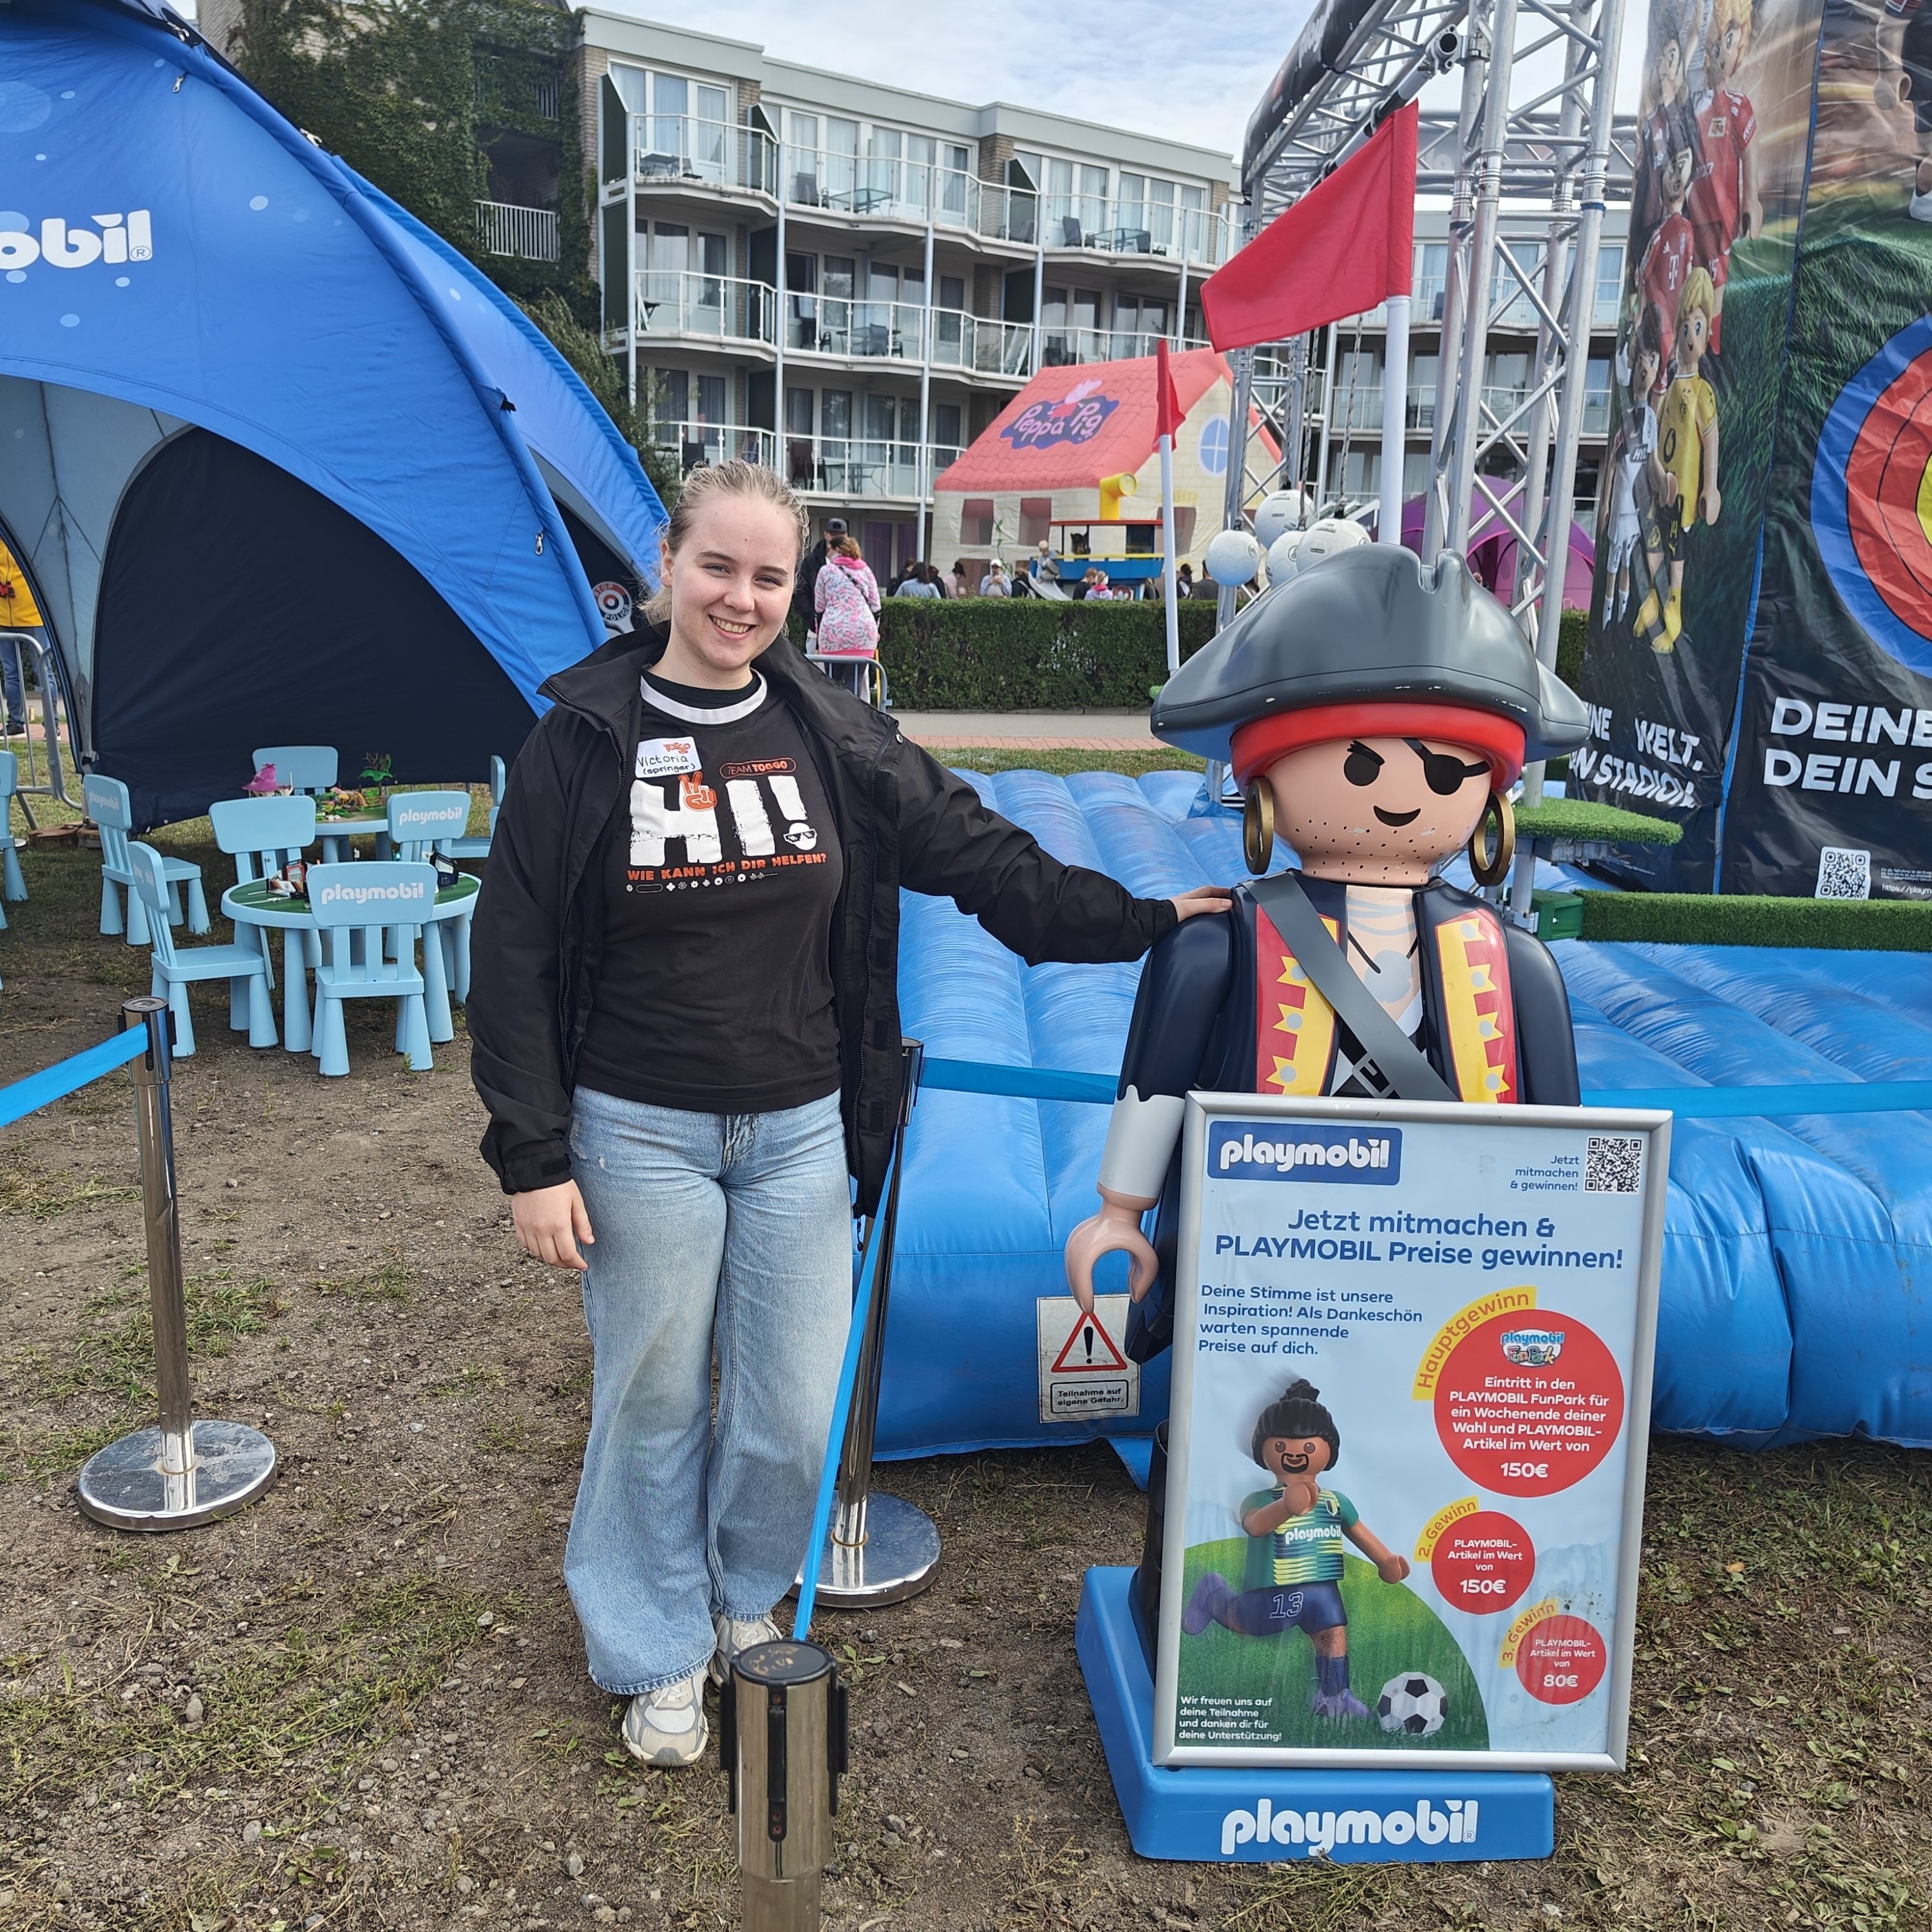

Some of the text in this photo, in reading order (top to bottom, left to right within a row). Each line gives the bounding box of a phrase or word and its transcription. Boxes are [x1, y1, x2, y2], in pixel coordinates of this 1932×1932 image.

[1014, 402, 1103, 443] Peppa Pig
[593, 583, 614, 598] STOP
[1634, 717, 1703, 772] WELT.
[637, 755, 689, 767] Victoria
[1763, 748, 1901, 797] DEIN
[399, 806, 462, 826] playmobil
[630, 775, 817, 866] HI!
[627, 869, 654, 881] WIE
[661, 866, 706, 879] KANN
[741, 858, 766, 869] DIR
[772, 853, 827, 867] HELFEN?
[321, 882, 424, 905] playmobil
[1220, 1134, 1390, 1172] playmobil
[1551, 1155, 1580, 1164] Jetzt
[1515, 1166, 1578, 1178] mitmachen
[1510, 1180, 1578, 1191] & gewinnen!
[1288, 1209, 1555, 1237] Jetzt mitmachen &
[1216, 1235, 1623, 1271] PLAYMOBIL Preise gewinnen!
[1202, 1285, 1394, 1303] Deine Stimme ist unsere
[1204, 1303, 1423, 1322] Inspiration! Als Dankeschön
[1199, 1323, 1349, 1341] warten spannende
[1501, 1331, 1564, 1346] playmobil
[1198, 1340, 1318, 1355] Preise auf dich.
[1417, 1293, 1530, 1388] Hauptgewinn
[1485, 1376, 1575, 1390] Eintritt in den
[1450, 1392, 1609, 1406] PLAYMOBIL FunPark für
[1451, 1406, 1607, 1422] ein Wochenende deiner
[1452, 1422, 1602, 1437] Wahl und PLAYMOBIL-
[1463, 1438, 1590, 1452] Artikel im Wert von
[1501, 1463, 1549, 1477] 150€
[1285, 1525, 1342, 1544] playmobil
[1419, 1502, 1476, 1557] 2. Gewinn
[1454, 1539, 1517, 1548] PLAYMOBIL-
[1448, 1551, 1522, 1560] Artikel im Wert
[1460, 1579, 1506, 1594] 150€
[1269, 1591, 1303, 1618] 13
[1502, 1604, 1555, 1661] 3. Gewinn
[1543, 1674, 1578, 1687] 80€
[1180, 1696, 1198, 1704] Wir
[1200, 1696, 1232, 1705] freuen
[1255, 1698, 1273, 1706] auf
[1180, 1707, 1259, 1717] deine Teilnahme
[1179, 1719, 1269, 1728] und danken dir für
[1179, 1730, 1282, 1742] deine Unterstützung!
[1221, 1798, 1479, 1856] playmobil
